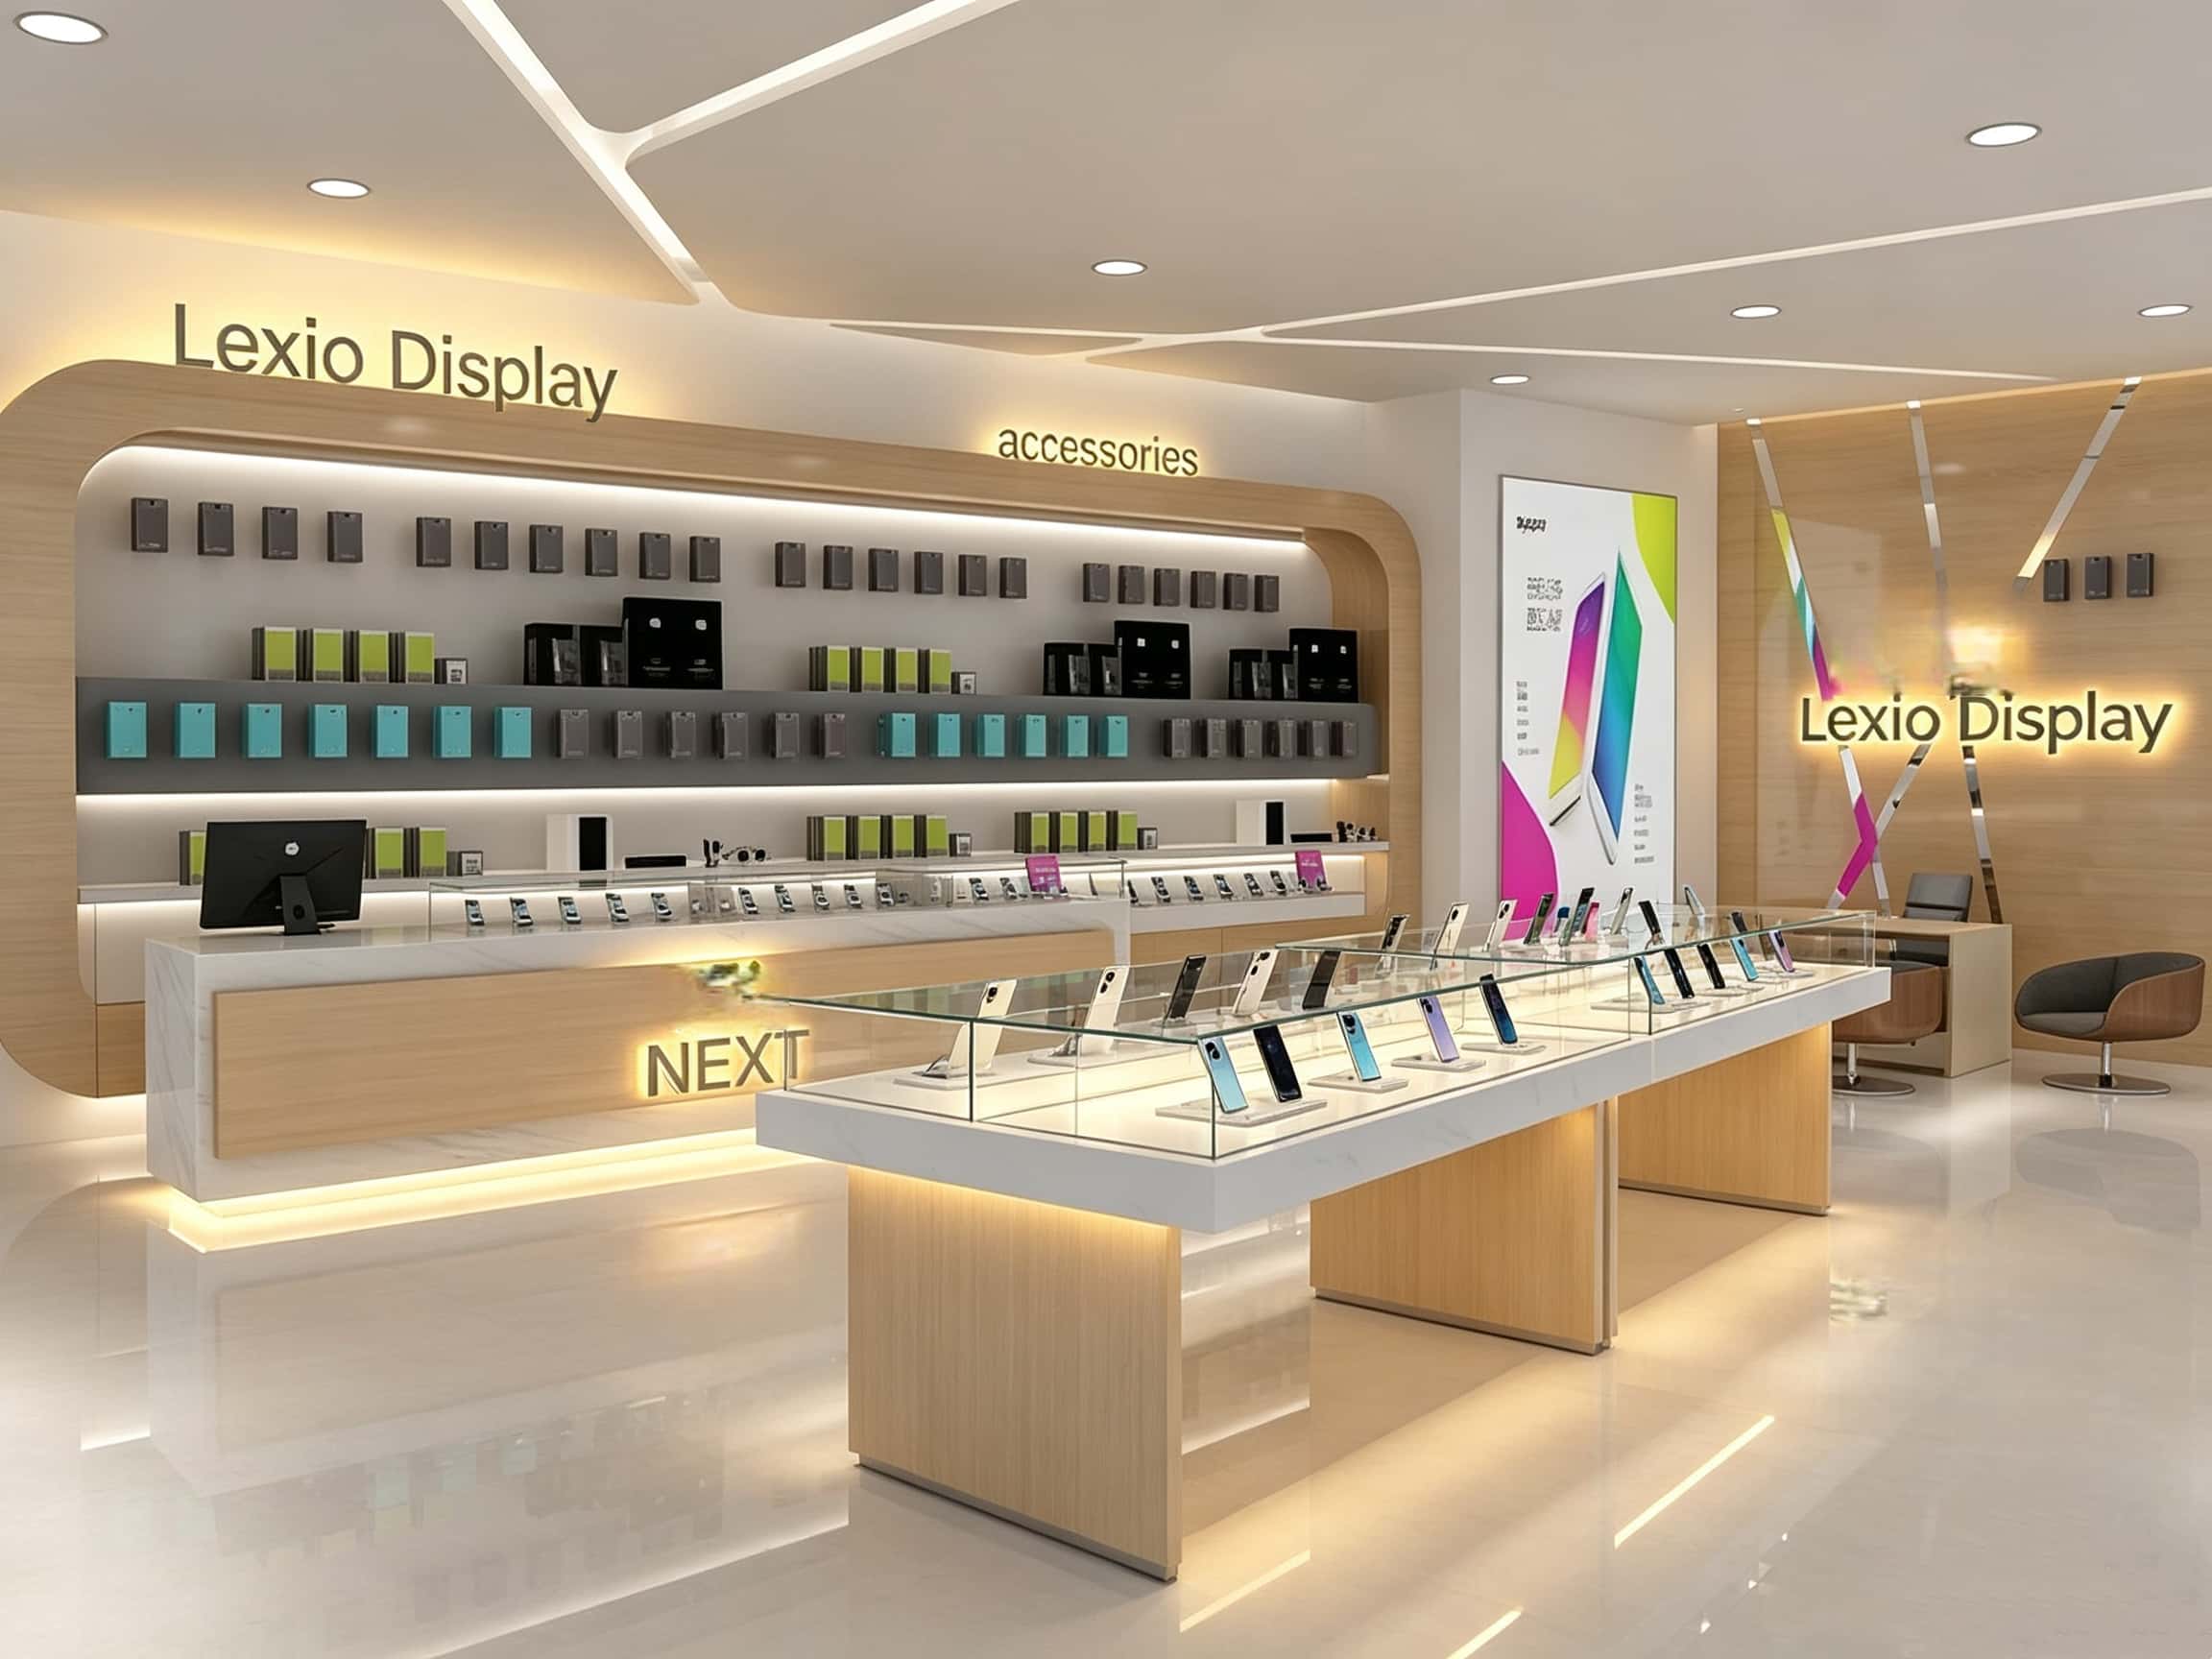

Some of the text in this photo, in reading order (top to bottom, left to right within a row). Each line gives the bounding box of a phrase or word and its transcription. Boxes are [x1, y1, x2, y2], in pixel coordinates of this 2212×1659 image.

[175, 303, 618, 423] Lexio Display
[998, 429, 1198, 476] accessories
[1801, 690, 2173, 755] Lexio Display
[648, 1029, 809, 1097] NEXT
